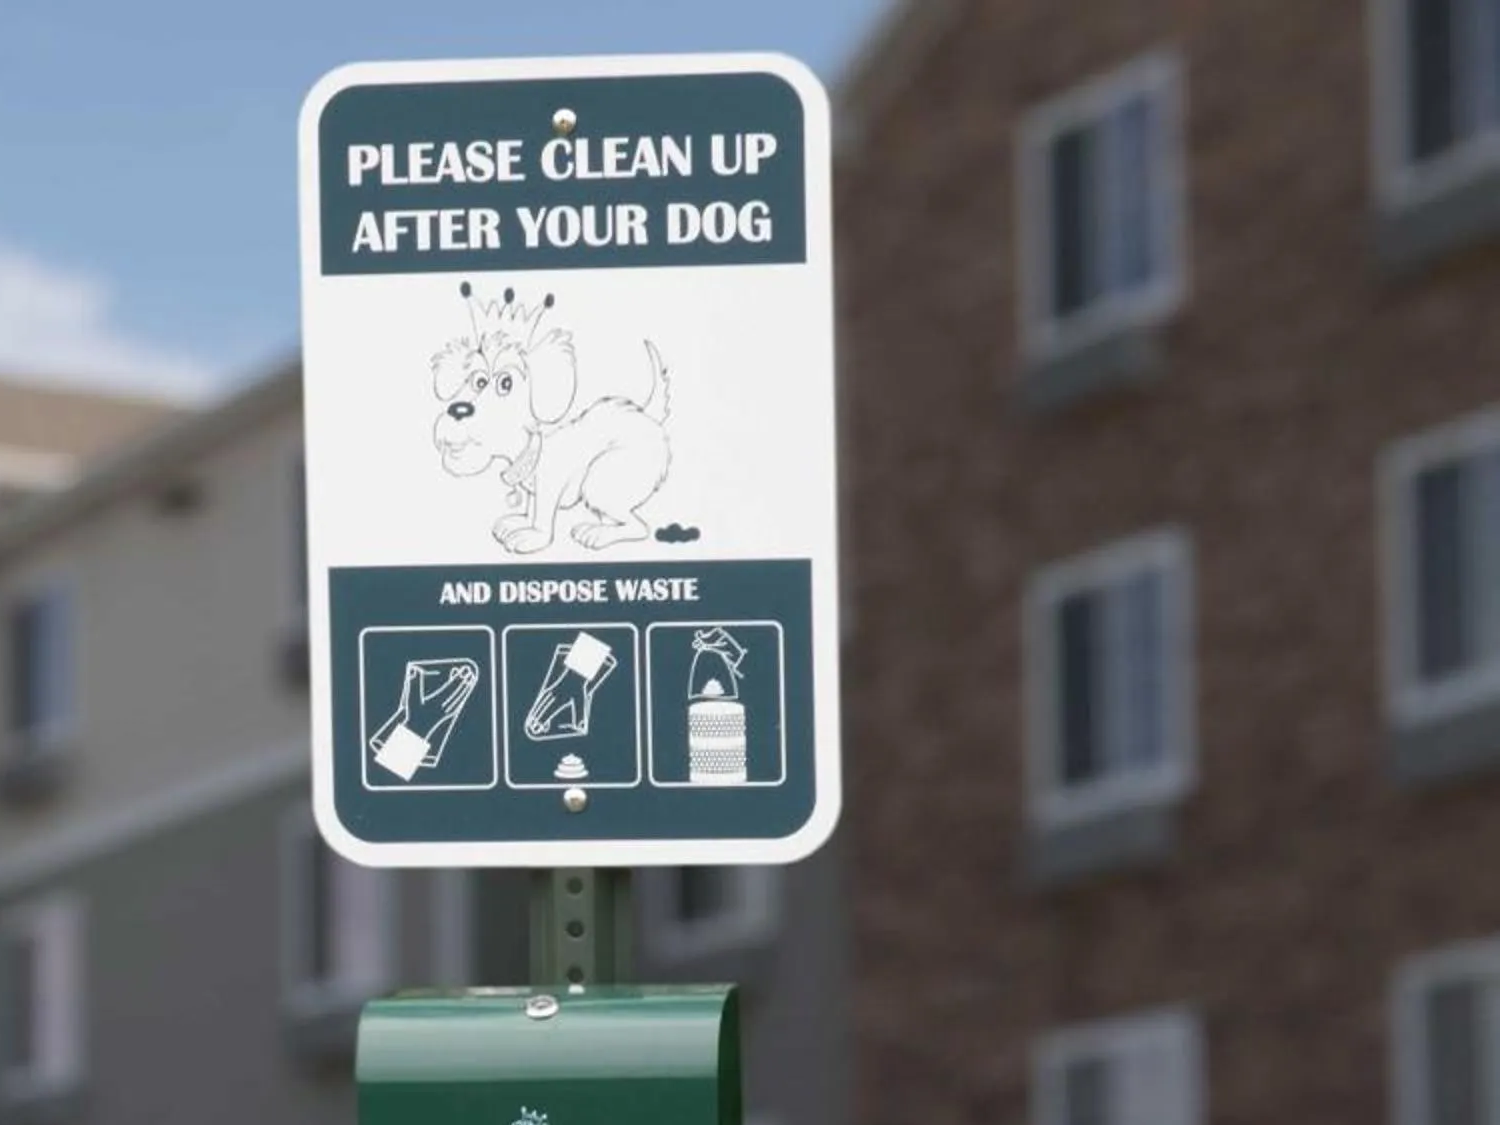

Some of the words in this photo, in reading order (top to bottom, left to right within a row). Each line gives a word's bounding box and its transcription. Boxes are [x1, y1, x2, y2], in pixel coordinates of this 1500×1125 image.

[347, 139, 526, 186] PLEASE
[540, 135, 692, 181] CLEAN
[710, 133, 777, 175] UP
[351, 208, 501, 254] AFTER
[516, 204, 649, 248] YOUR
[666, 200, 773, 245] DOG
[439, 581, 492, 605] AND
[499, 579, 609, 604] DISPOSE
[615, 577, 700, 602] WASTE
